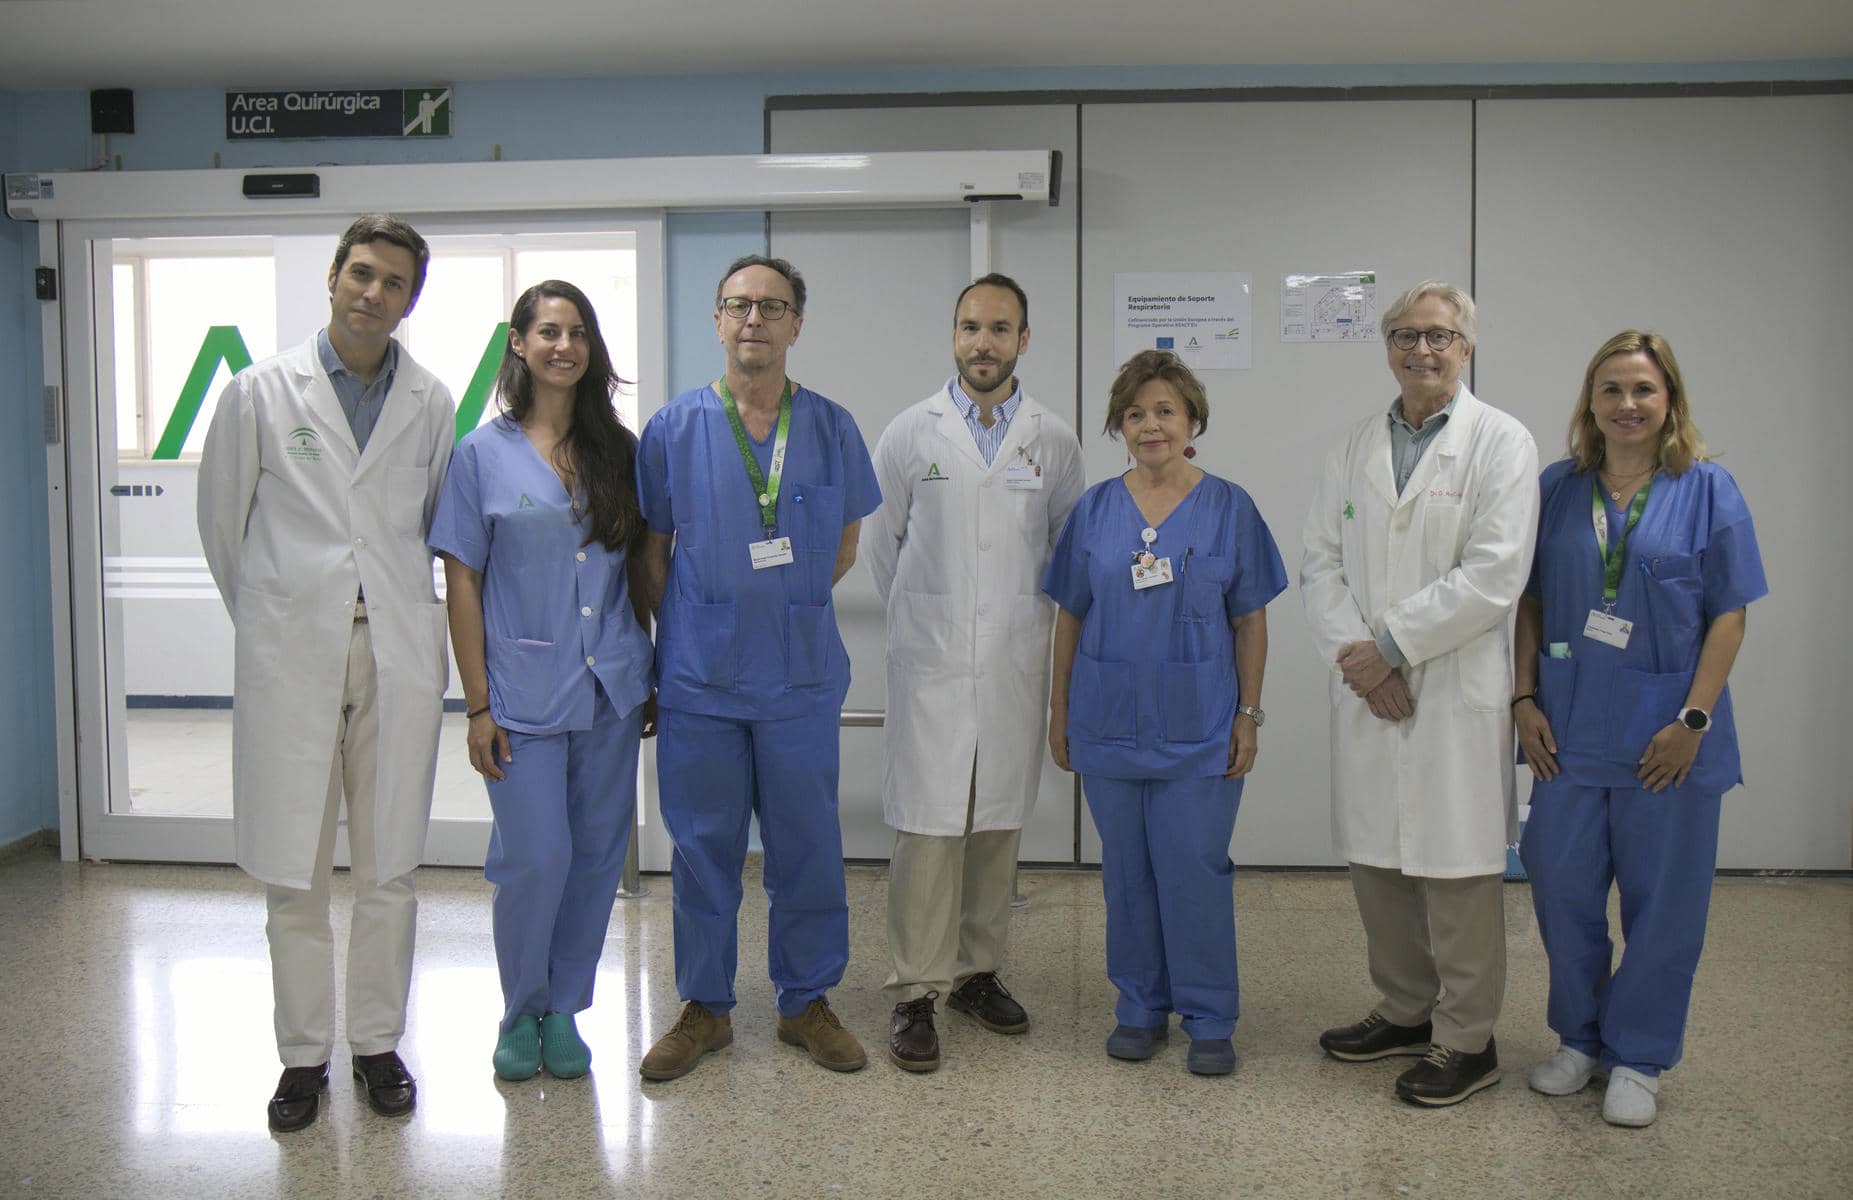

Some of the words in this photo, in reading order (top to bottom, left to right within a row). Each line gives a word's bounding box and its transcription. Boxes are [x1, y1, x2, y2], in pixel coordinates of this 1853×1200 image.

[231, 94, 277, 112] Area
[283, 92, 381, 114] Quirúrgica
[231, 116, 275, 134] U.C.I.
[1128, 296, 1176, 304] Equipamiento
[1188, 295, 1215, 303] Soporte
